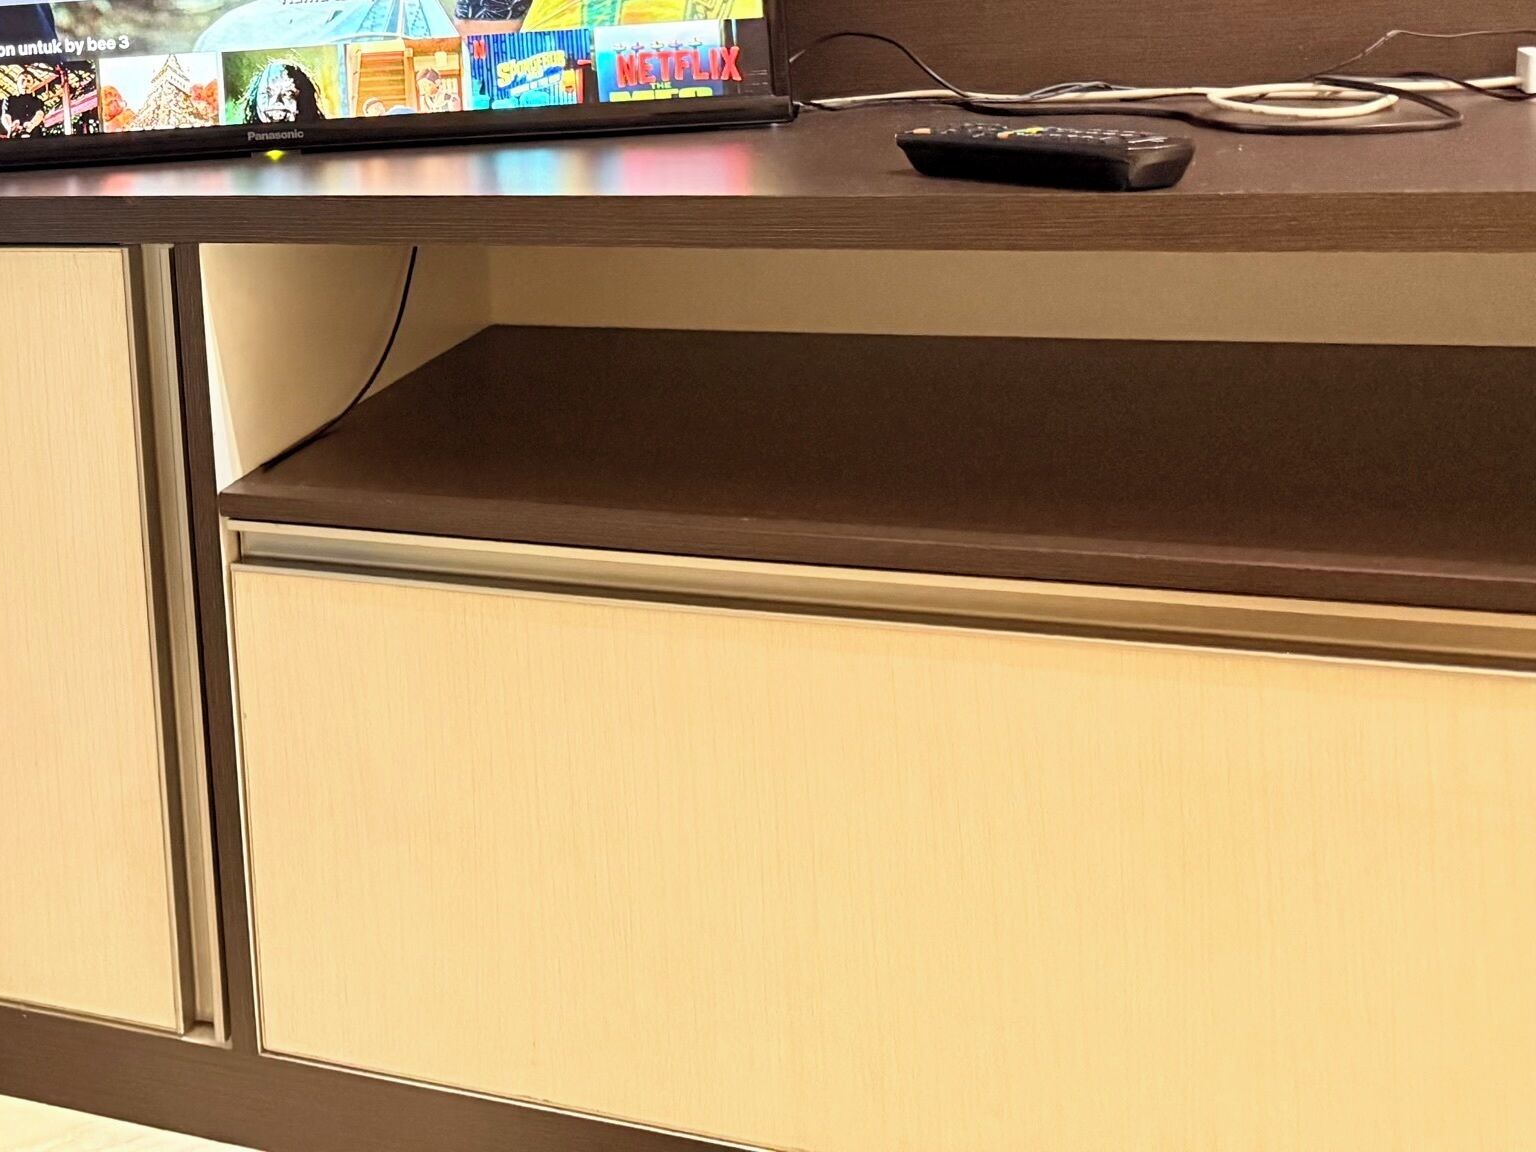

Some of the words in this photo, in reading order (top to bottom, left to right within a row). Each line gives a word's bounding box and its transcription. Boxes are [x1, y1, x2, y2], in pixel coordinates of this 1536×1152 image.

[17, 39, 63, 55] untuk
[64, 37, 86, 56] by
[87, 34, 117, 51] bee
[118, 34, 130, 49] 3
[616, 45, 742, 88] NETFLIX
[649, 81, 672, 90] THE
[247, 129, 304, 141] Panasonic
